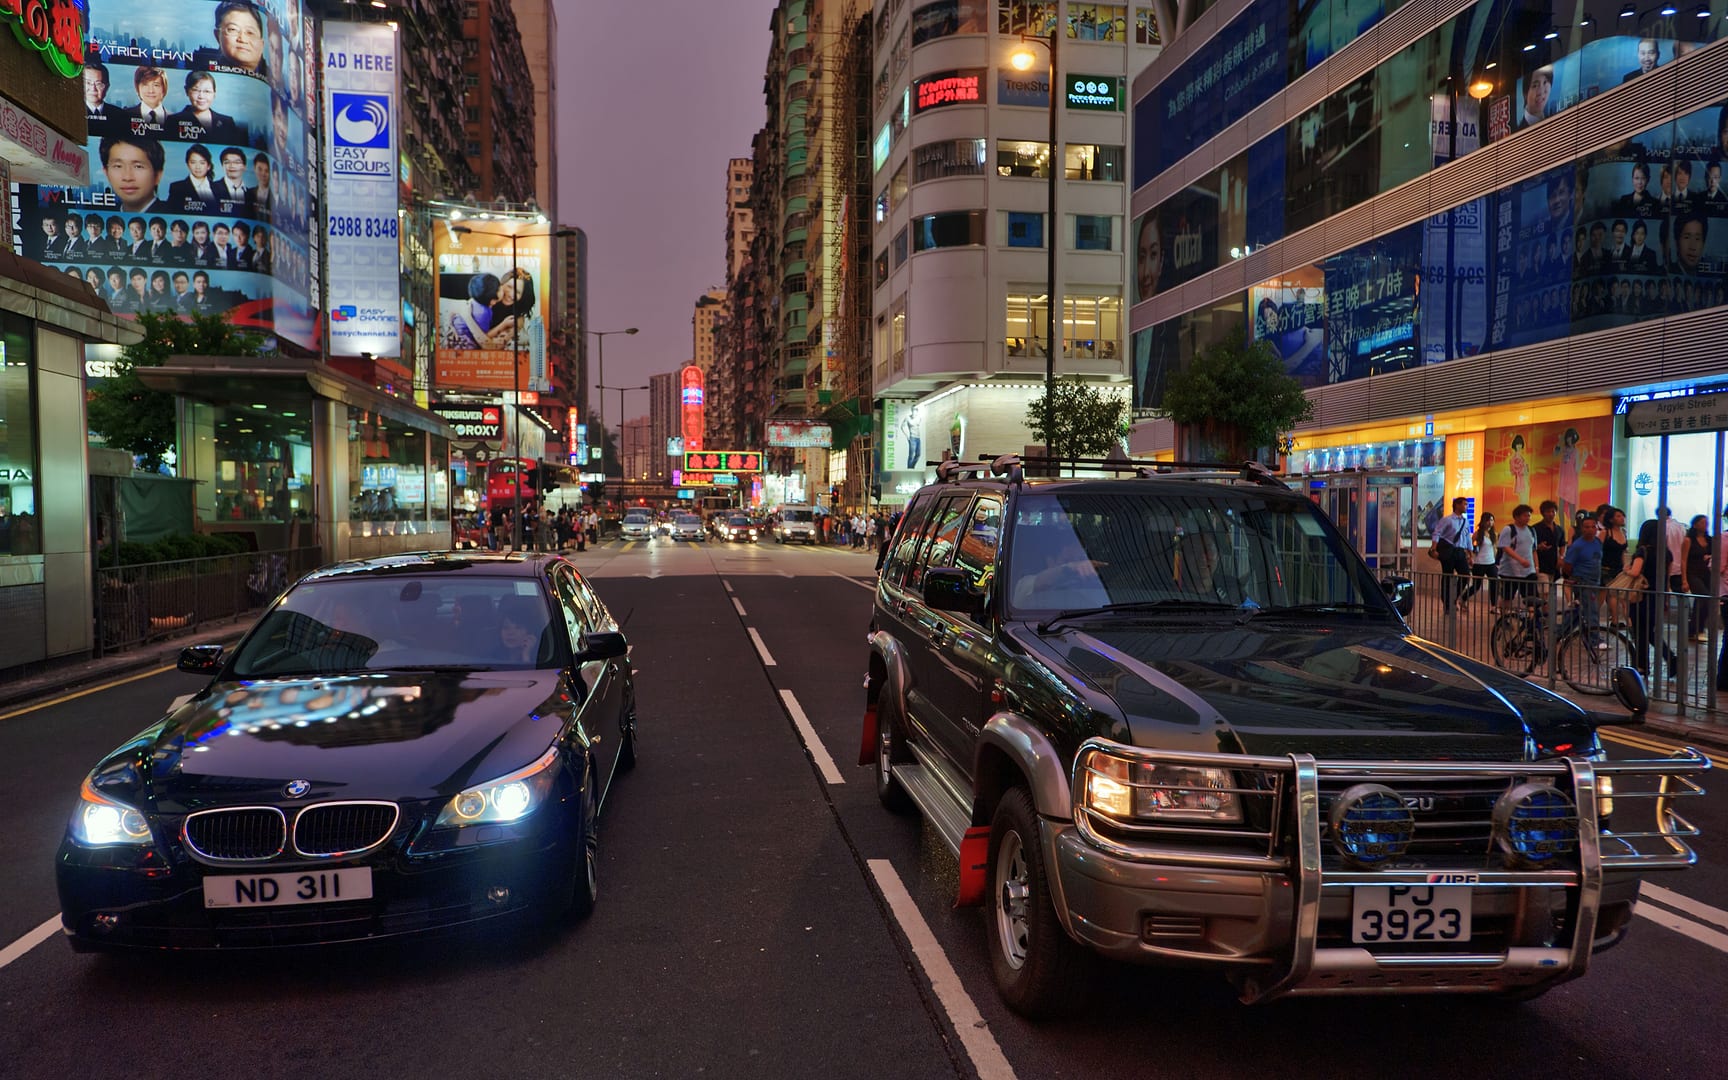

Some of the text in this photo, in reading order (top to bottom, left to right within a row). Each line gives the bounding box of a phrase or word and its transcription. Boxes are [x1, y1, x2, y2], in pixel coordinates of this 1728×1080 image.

[90, 44, 193, 62] PATRICK CHAN
[327, 52, 393, 71] AD HERE
[131, 122, 164, 131] DANIEL
[179, 126, 206, 135] LINDA
[333, 147, 368, 159] EASY
[333, 159, 391, 173] GROUPS
[41, 190, 116, 206] W.L.LEE
[329, 216, 397, 238] 2988 8348
[1656, 398, 1717, 413] Argyle Street
[465, 425, 499, 436] ROXY
[1659, 414, 1712, 431] 亞皆老街
[887, 441, 895, 470] DENIM
[235, 873, 340, 904] ND 311
[1389, 886, 1434, 907] PJ
[1360, 908, 1462, 942] 3923
